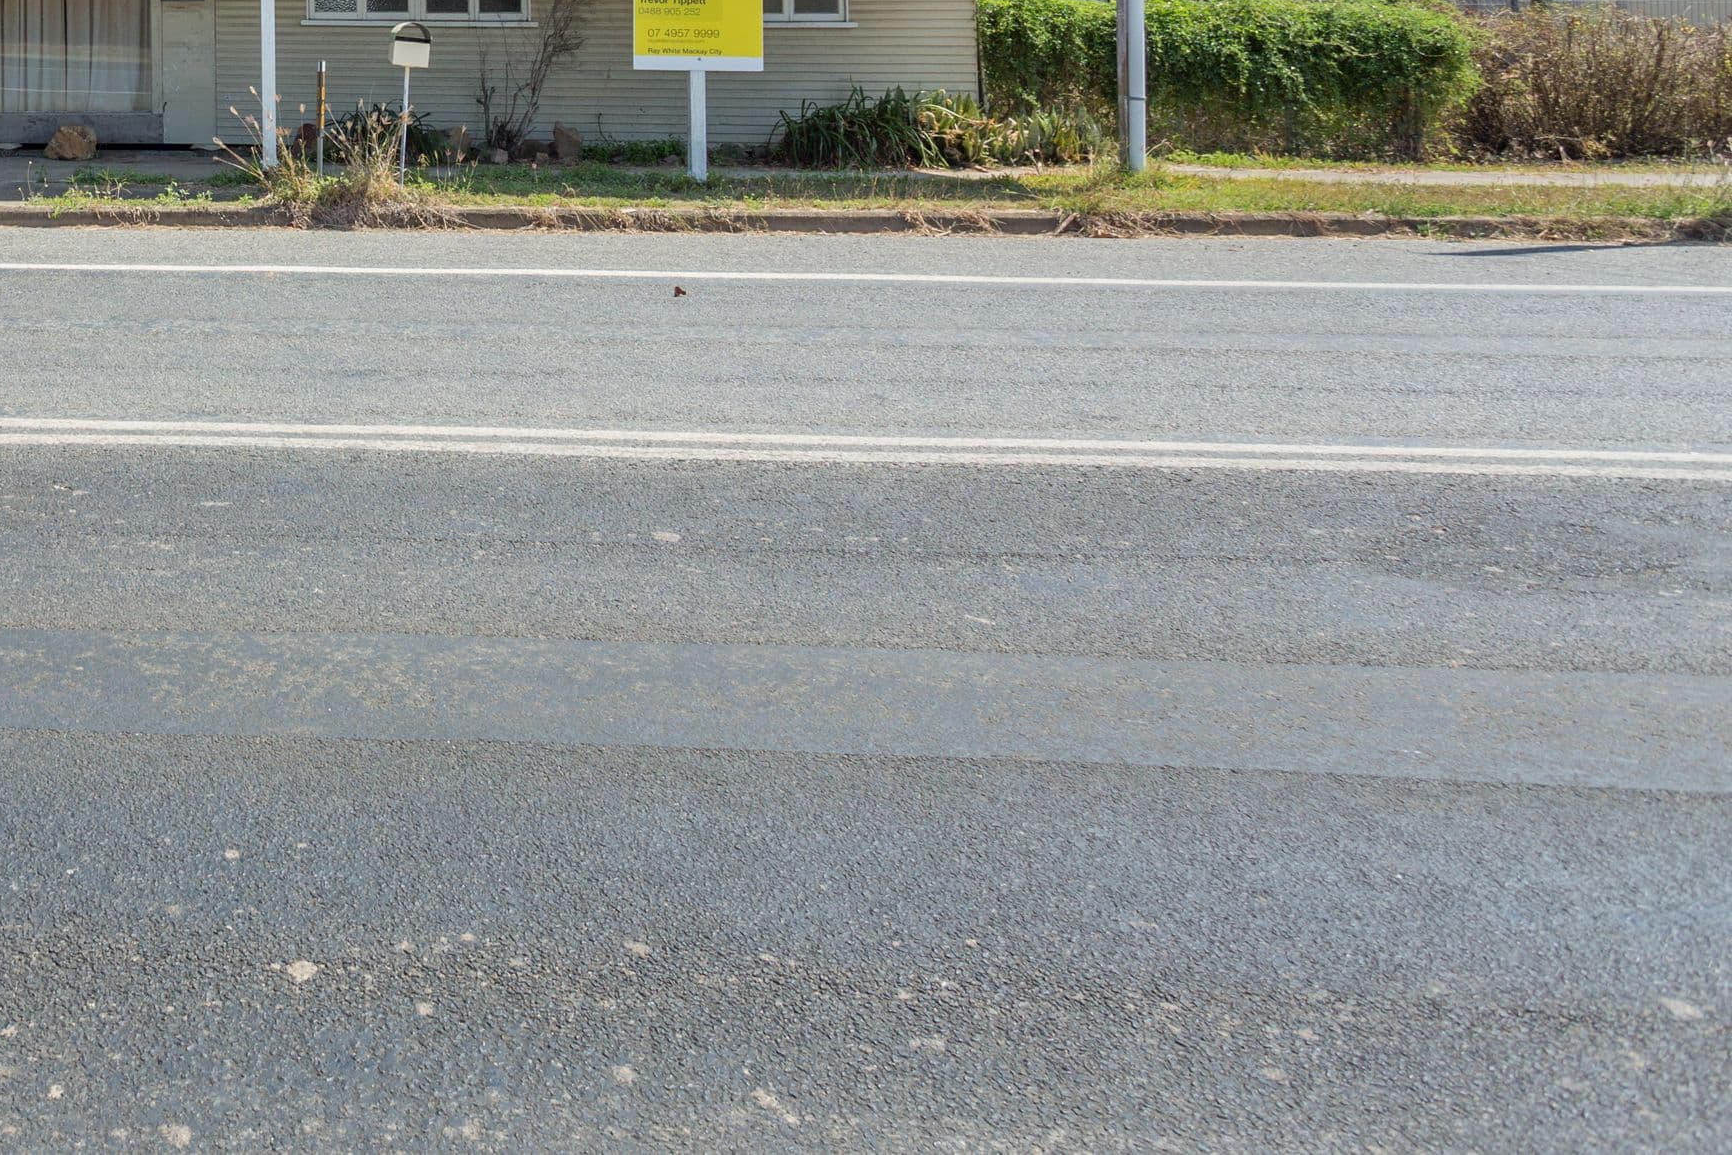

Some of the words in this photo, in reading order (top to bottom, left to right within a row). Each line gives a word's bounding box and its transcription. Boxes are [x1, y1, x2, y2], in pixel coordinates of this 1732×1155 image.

[638, 7, 661, 15] 0488
[663, 7, 682, 15] 905
[684, 8, 701, 16] 252
[647, 29, 660, 38] 07
[664, 29, 690, 38] 4957
[693, 29, 720, 38] 9999
